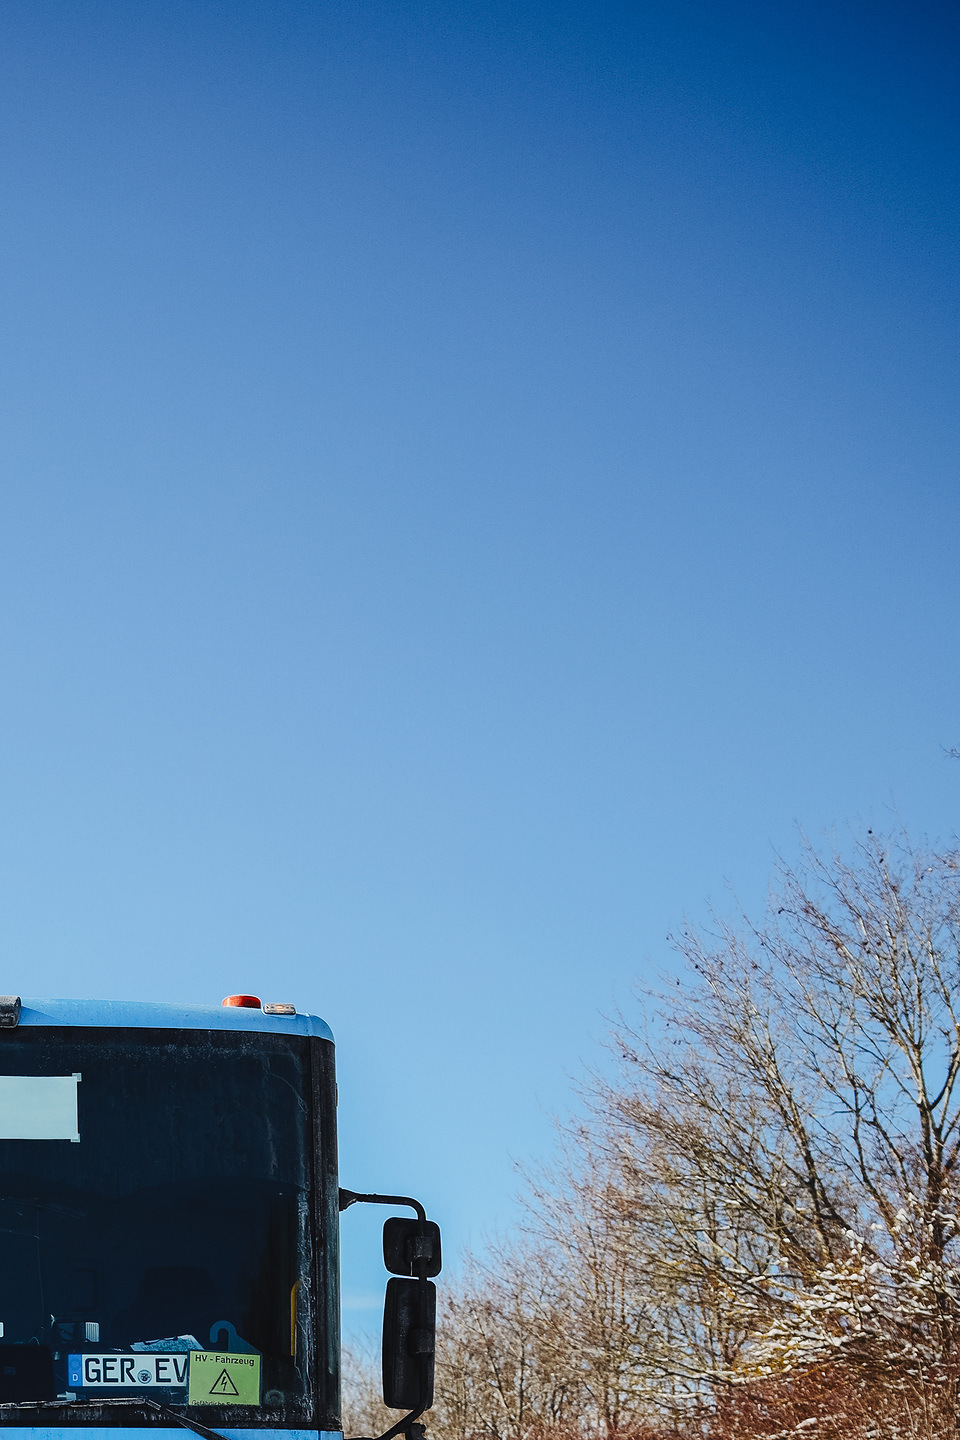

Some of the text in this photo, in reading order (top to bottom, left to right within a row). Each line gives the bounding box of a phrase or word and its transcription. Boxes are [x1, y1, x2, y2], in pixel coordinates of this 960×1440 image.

[195, 1354, 208, 1362] HV
[215, 1355, 255, 1366] Fahrzeug
[85, 1358, 188, 1382] GER EV
[72, 1373, 79, 1382] D
